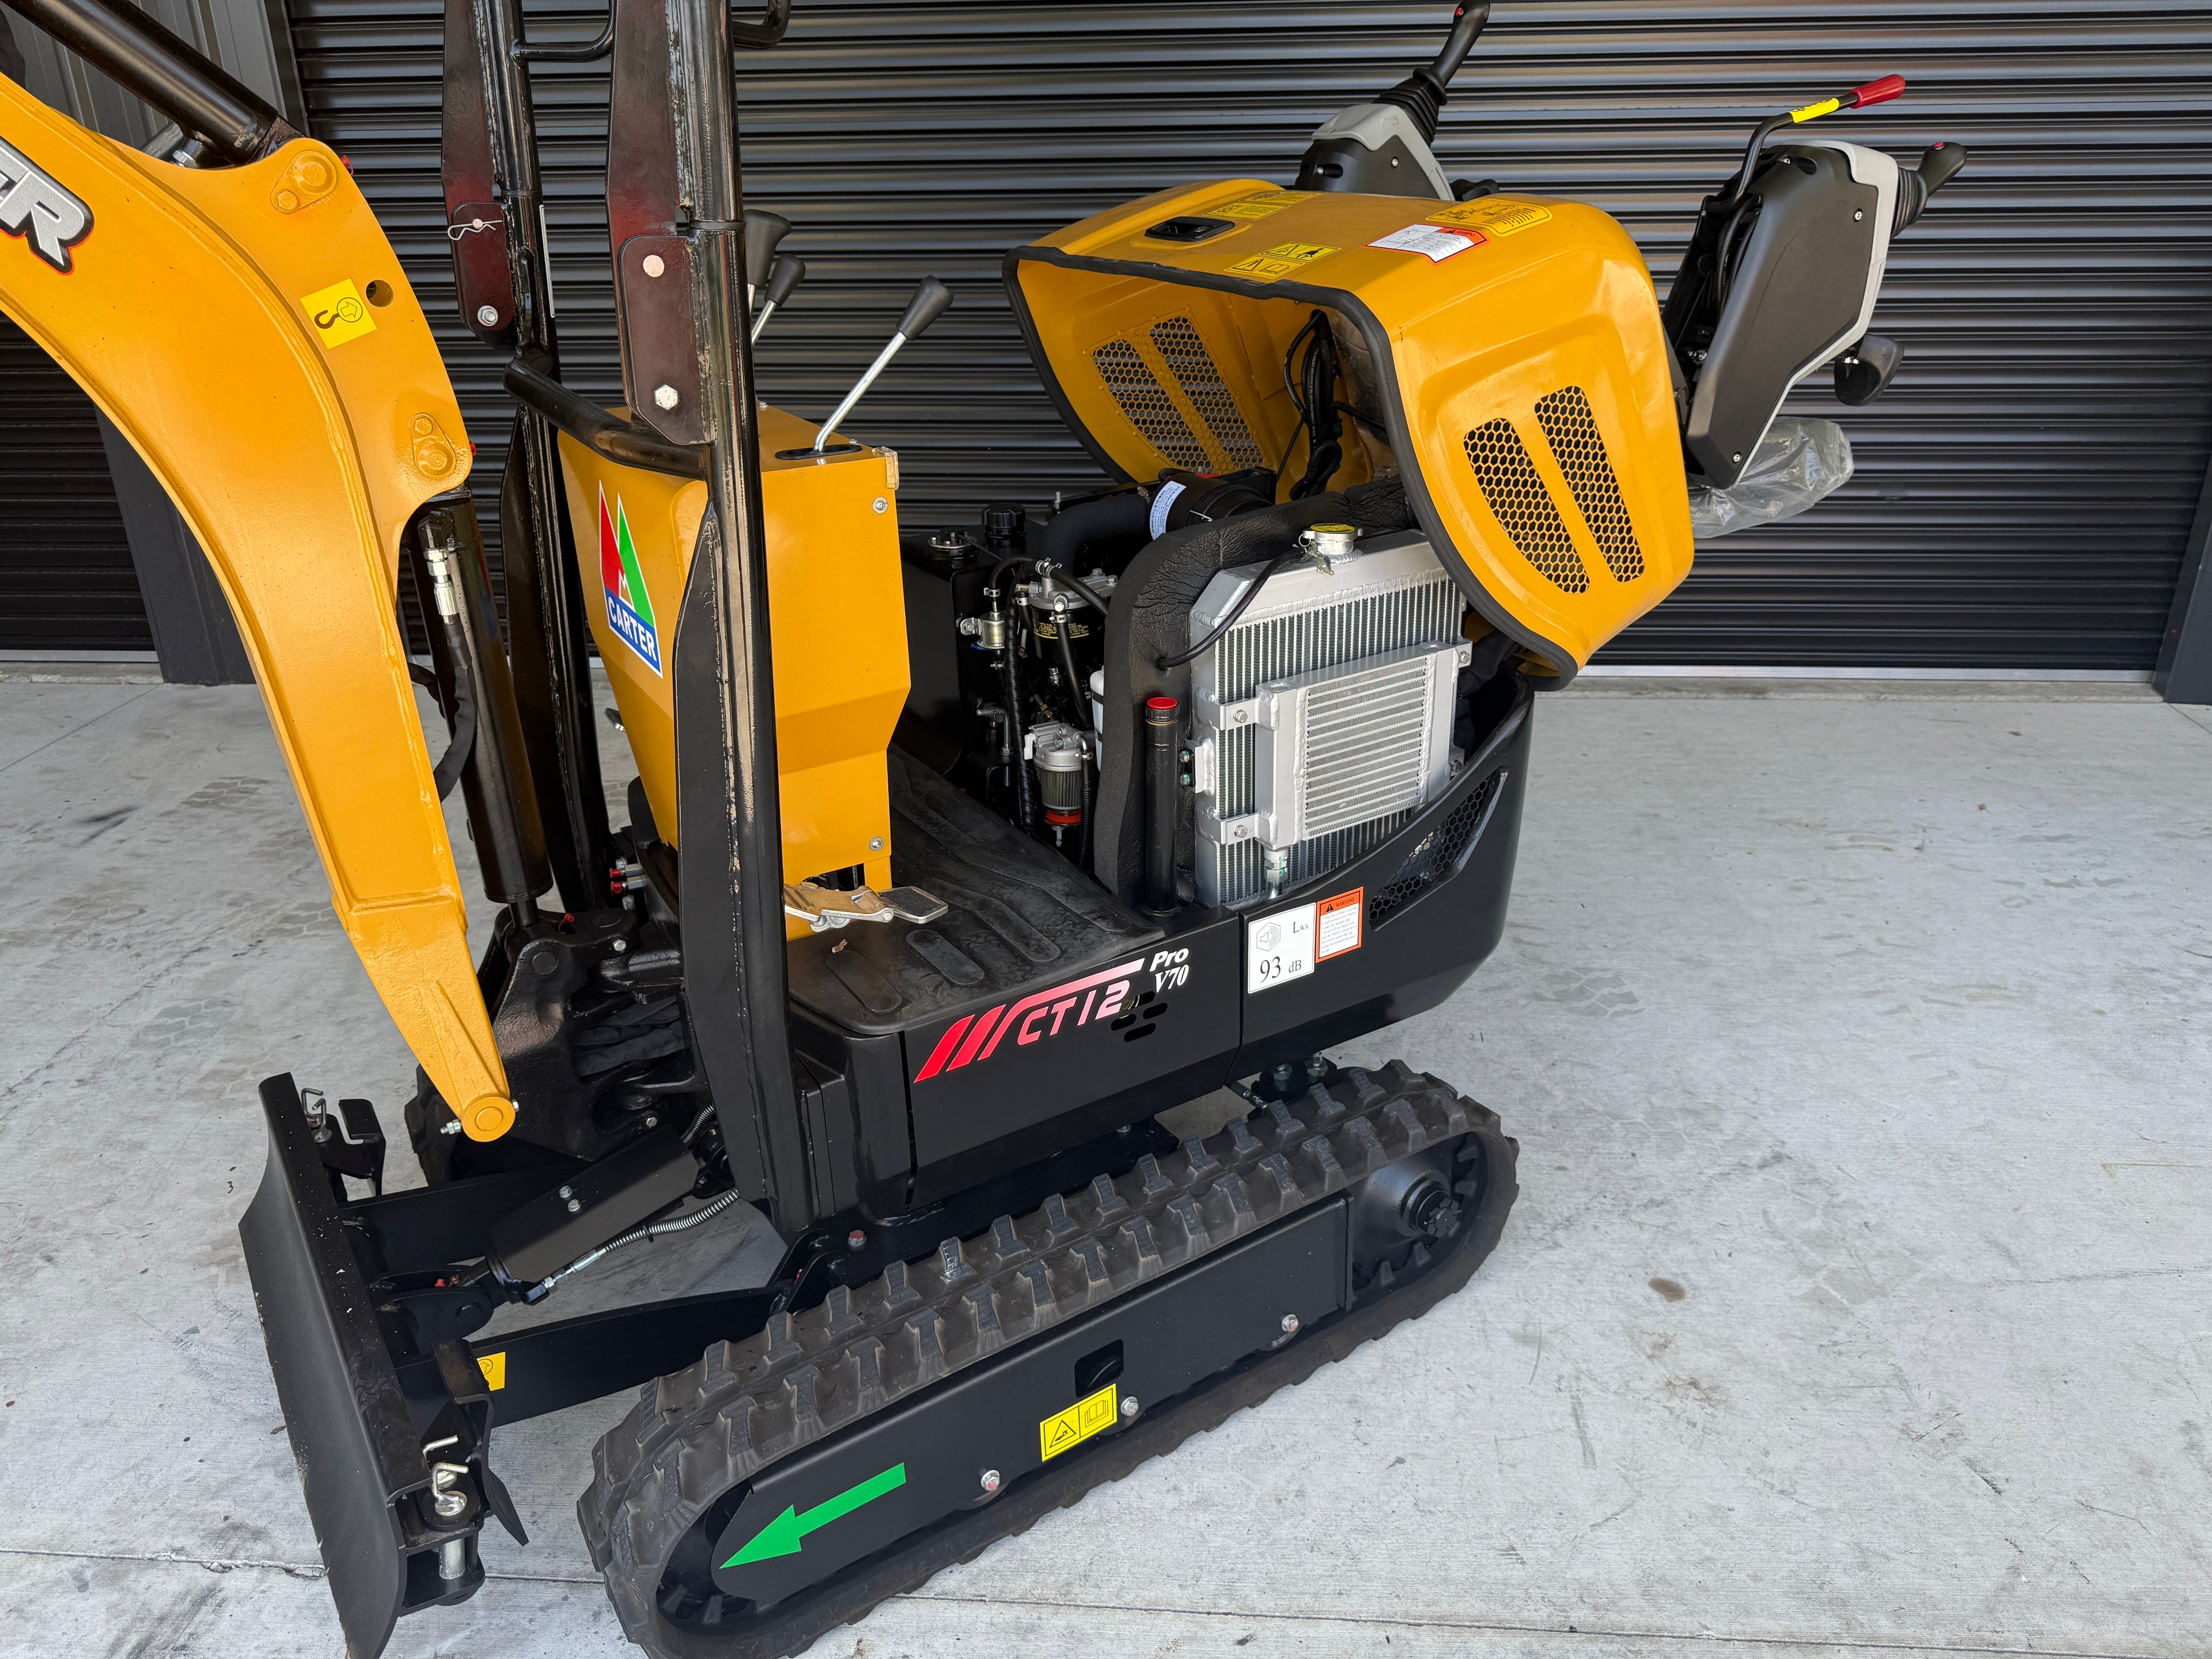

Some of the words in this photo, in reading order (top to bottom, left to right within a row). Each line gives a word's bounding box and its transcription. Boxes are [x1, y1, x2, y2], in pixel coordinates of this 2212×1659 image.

[0, 139, 91, 270] R
[608, 596, 657, 662] CARTER
[1149, 948, 1189, 972] Pro
[1155, 964, 1190, 993] V70
[1260, 956, 1281, 983] 93
[1288, 960, 1302, 973] dB
[1017, 980, 1124, 1046] CT12
